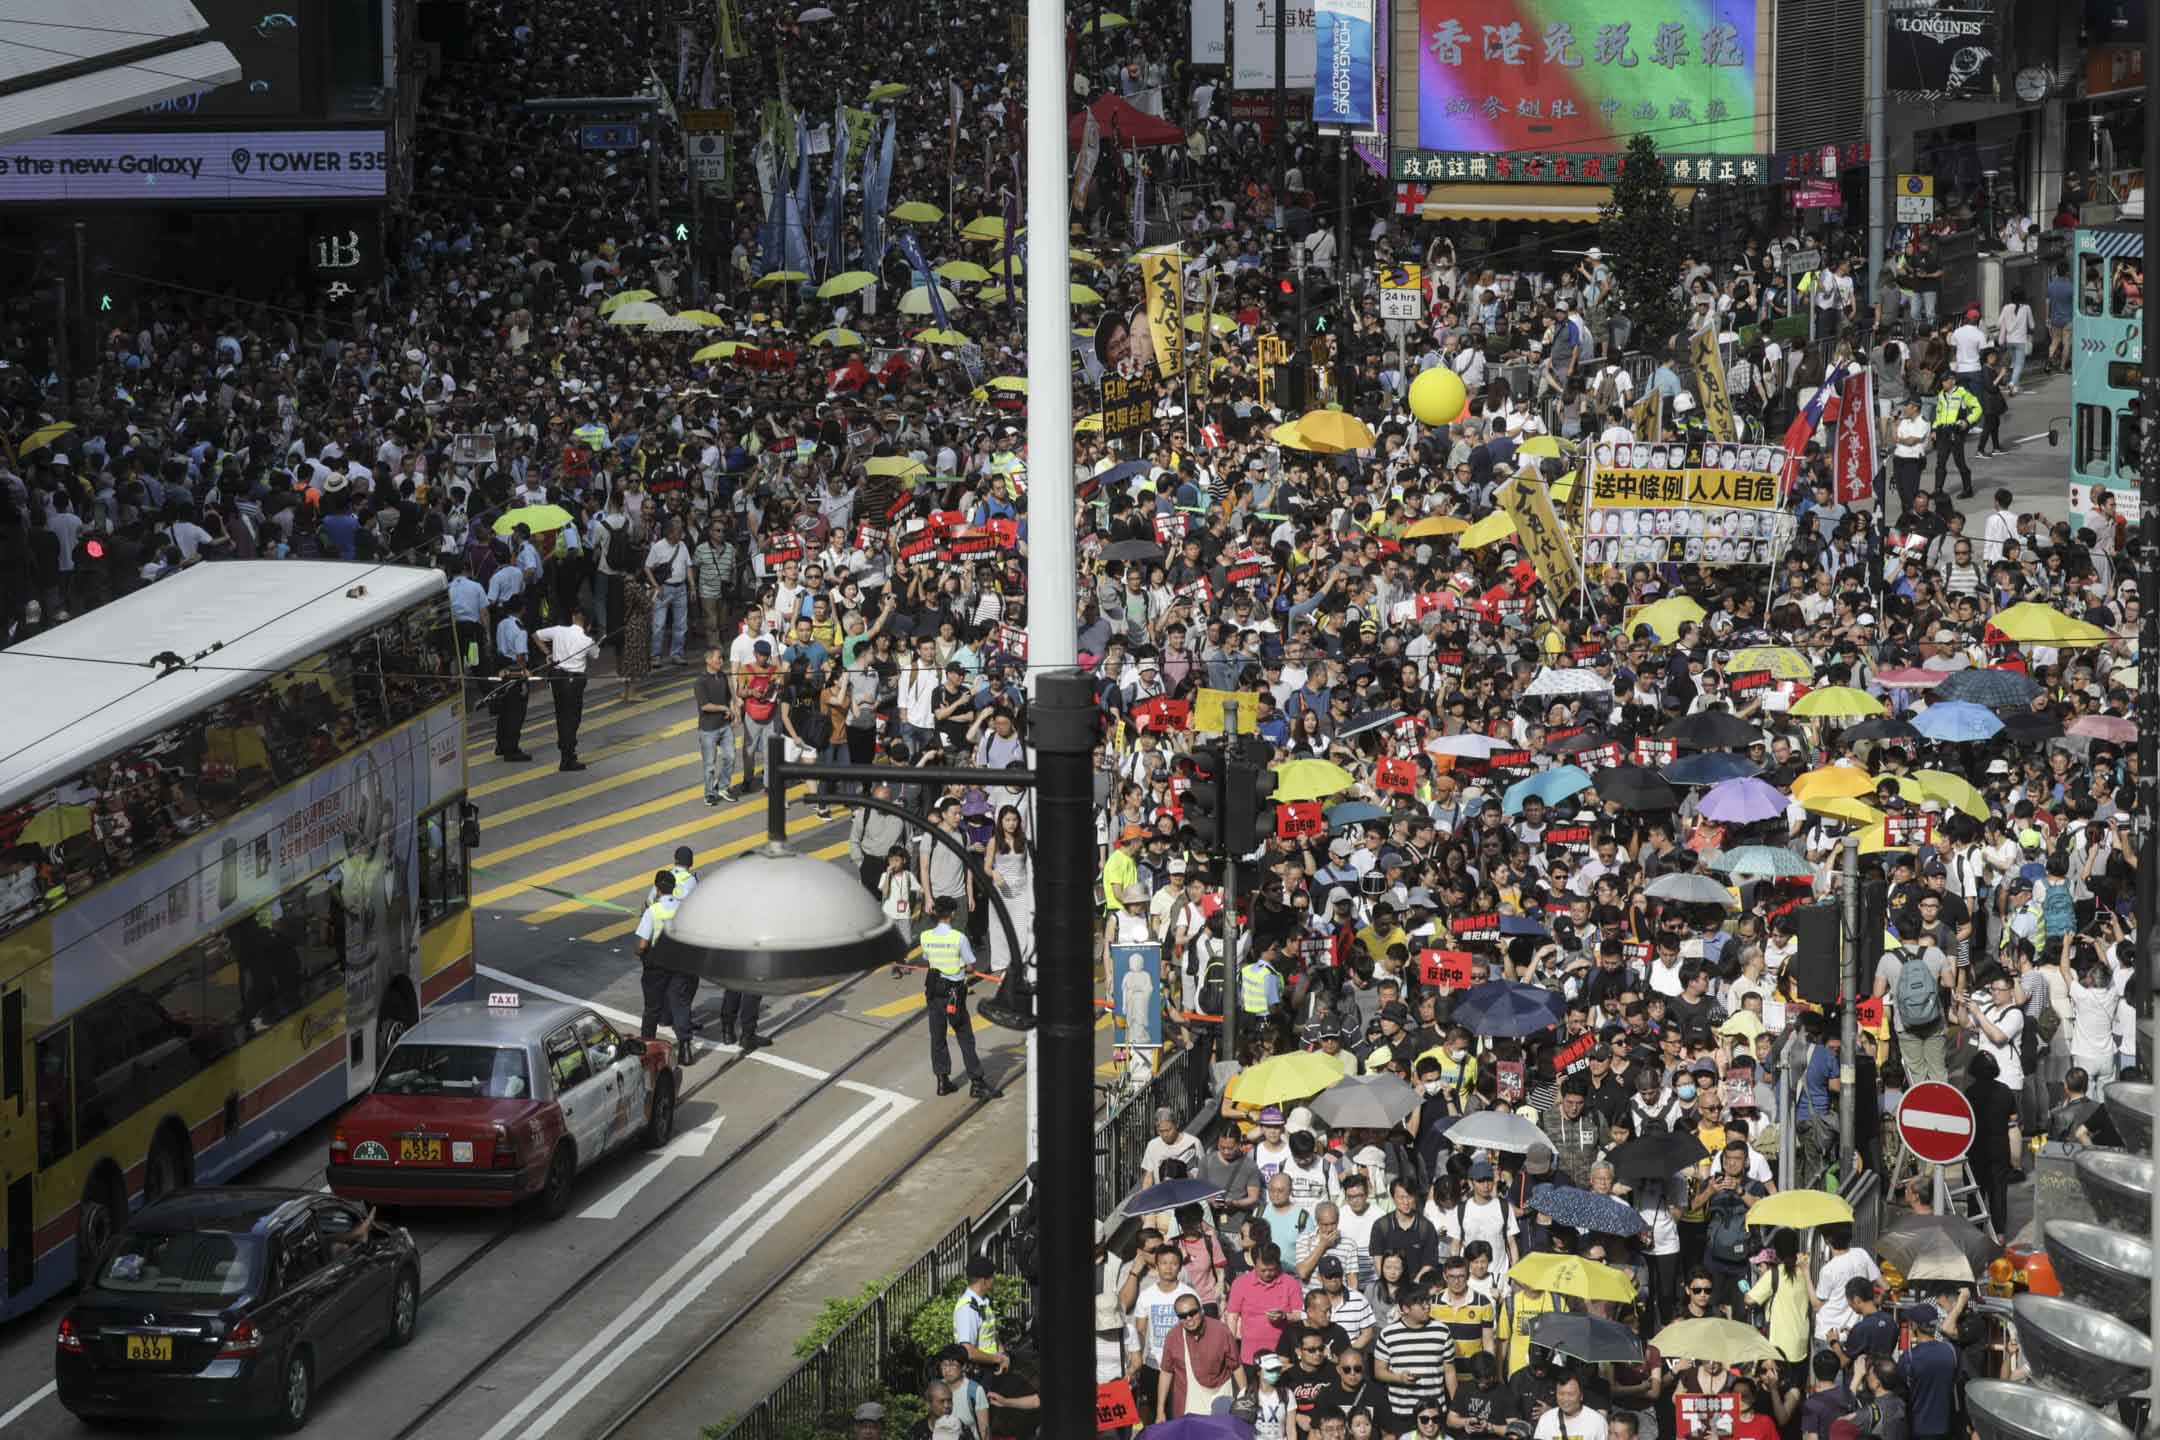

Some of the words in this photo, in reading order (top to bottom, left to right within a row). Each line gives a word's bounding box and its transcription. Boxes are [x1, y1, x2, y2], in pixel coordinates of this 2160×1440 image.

[1902, 18, 1981, 35] LONGINES
[1339, 20, 1351, 73] HONG
[1339, 74, 1351, 114] KONG
[15, 155, 54, 174] the
[60, 159, 111, 174] new
[118, 155, 202, 179] Galaxy
[256, 152, 340, 172] TOWER
[349, 152, 386, 171] 535
[1404, 158, 1488, 178] 政府註冊
[1673, 159, 1759, 181] 優質正貨
[1384, 291, 1398, 302] 24
[1400, 291, 1416, 302] hrs
[1388, 303, 1413, 316] 全日
[1595, 474, 1683, 501] 送中條例
[1688, 475, 1777, 501] 人人自危
[1428, 967, 1463, 983] 反送中
[491, 995, 517, 1005] TAXI
[132, 1347, 167, 1359] 8891
